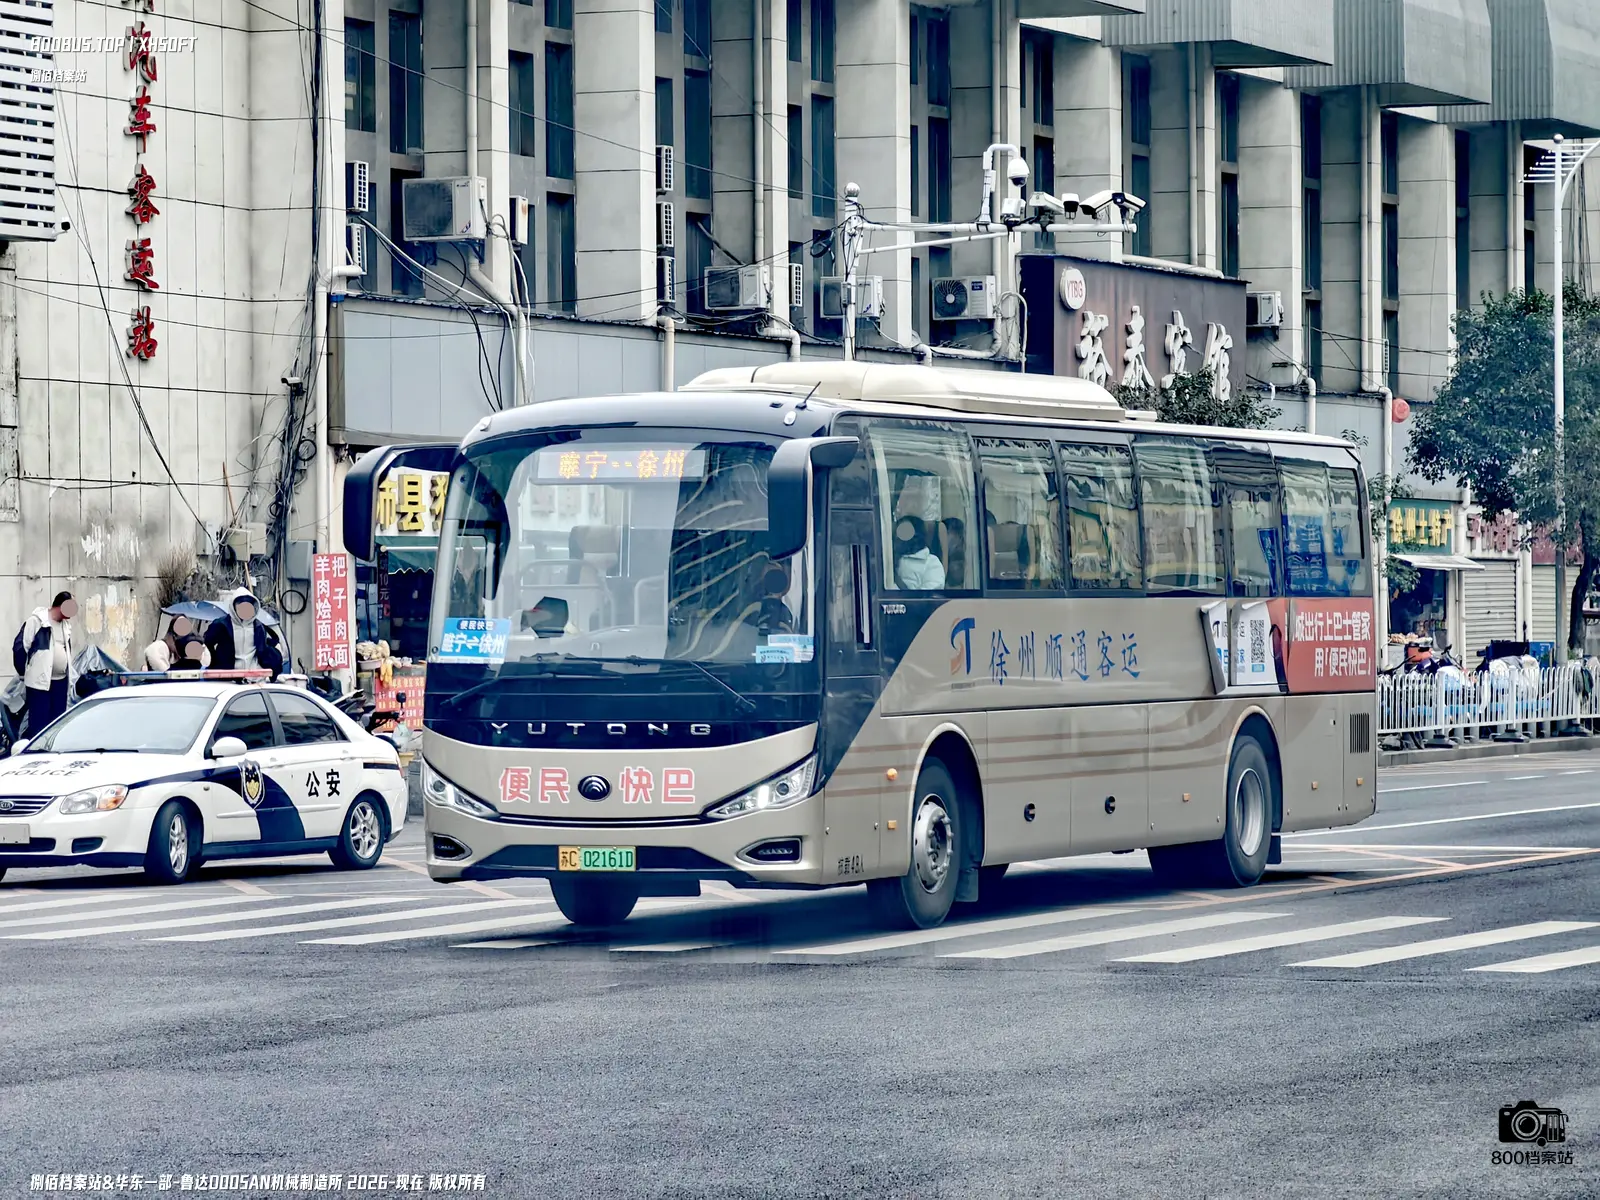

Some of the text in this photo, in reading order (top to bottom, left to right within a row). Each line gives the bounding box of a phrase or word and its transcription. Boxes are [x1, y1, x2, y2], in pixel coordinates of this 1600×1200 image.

[315, 556, 333, 641] 羊肉烩面
[332, 556, 347, 640] 把子肉
[1285, 611, 1371, 642] 城出行上巴士管家
[989, 628, 1141, 686] 徐州顺通客运
[491, 722, 711, 736] YUTONG
[306, 769, 340, 797] 公安
[583, 850, 633, 868] 02161D
